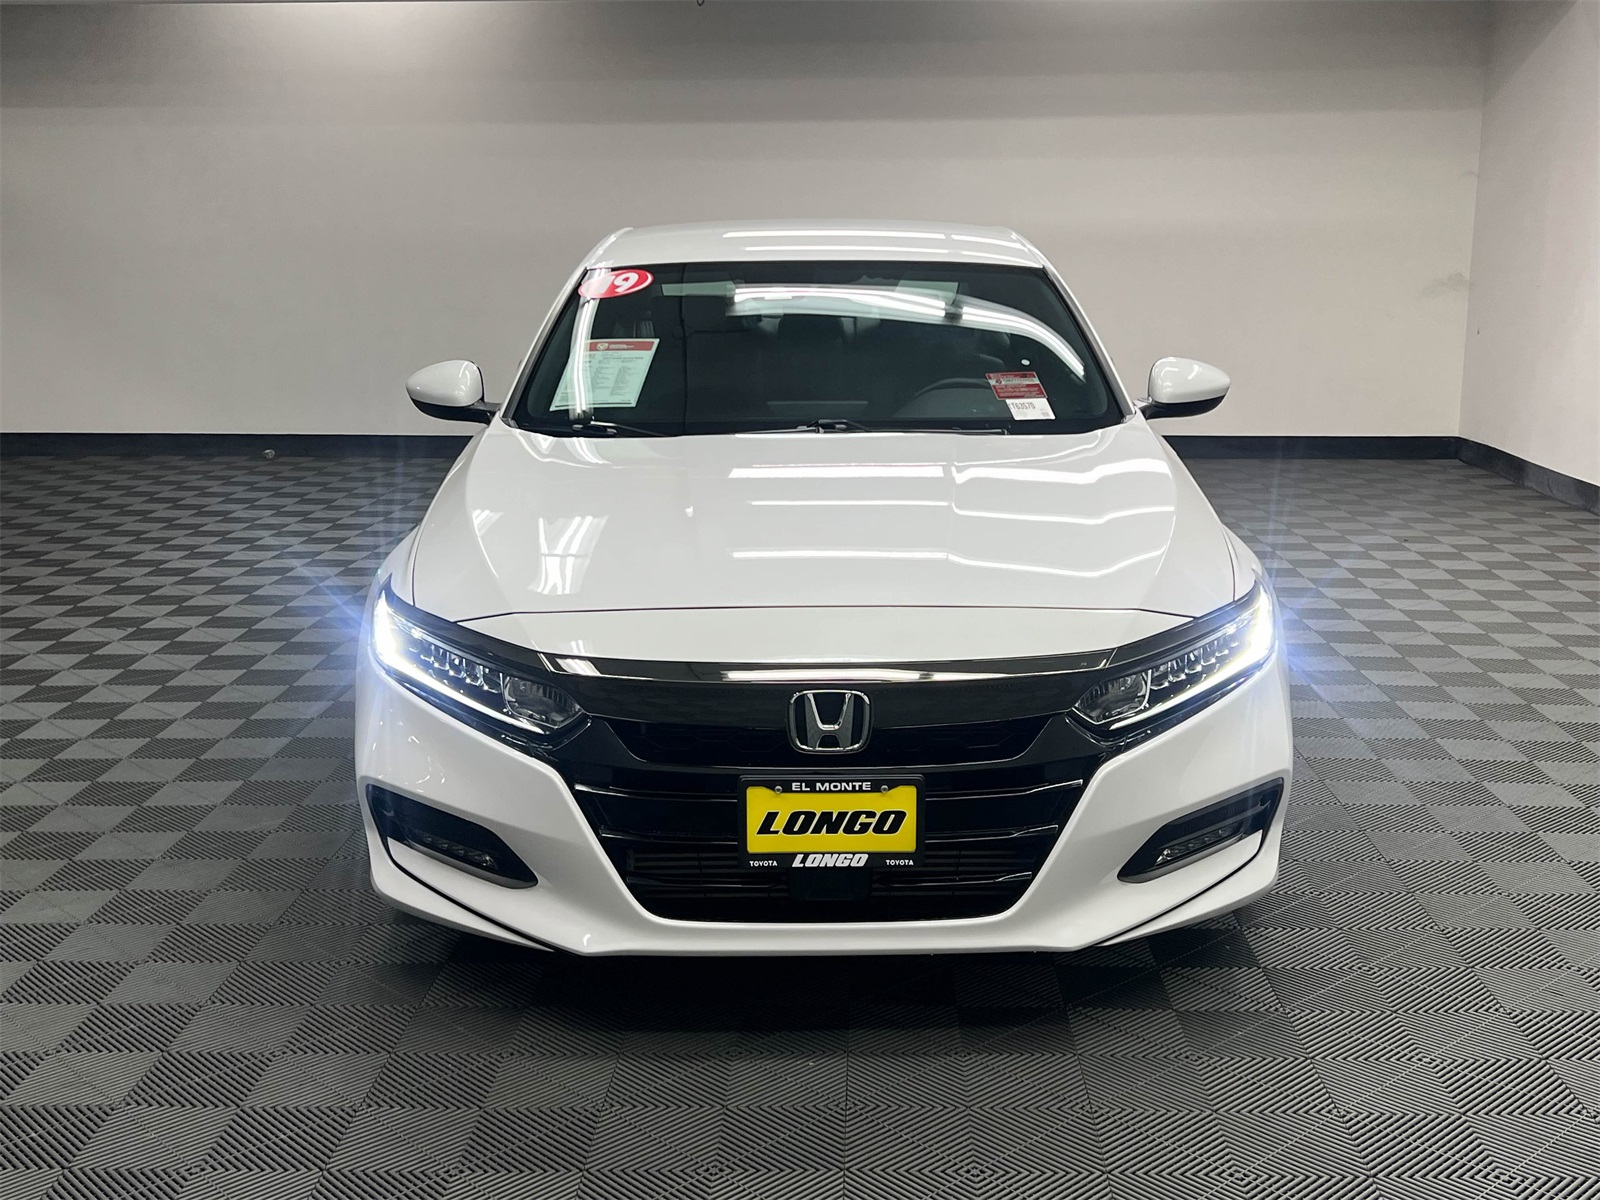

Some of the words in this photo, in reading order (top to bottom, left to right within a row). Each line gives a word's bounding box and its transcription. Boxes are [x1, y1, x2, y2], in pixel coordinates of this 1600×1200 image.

[791, 782, 810, 791] EL
[816, 782, 871, 791] MONTE
[756, 810, 907, 836] LONGO
[792, 854, 869, 867] LONGO
